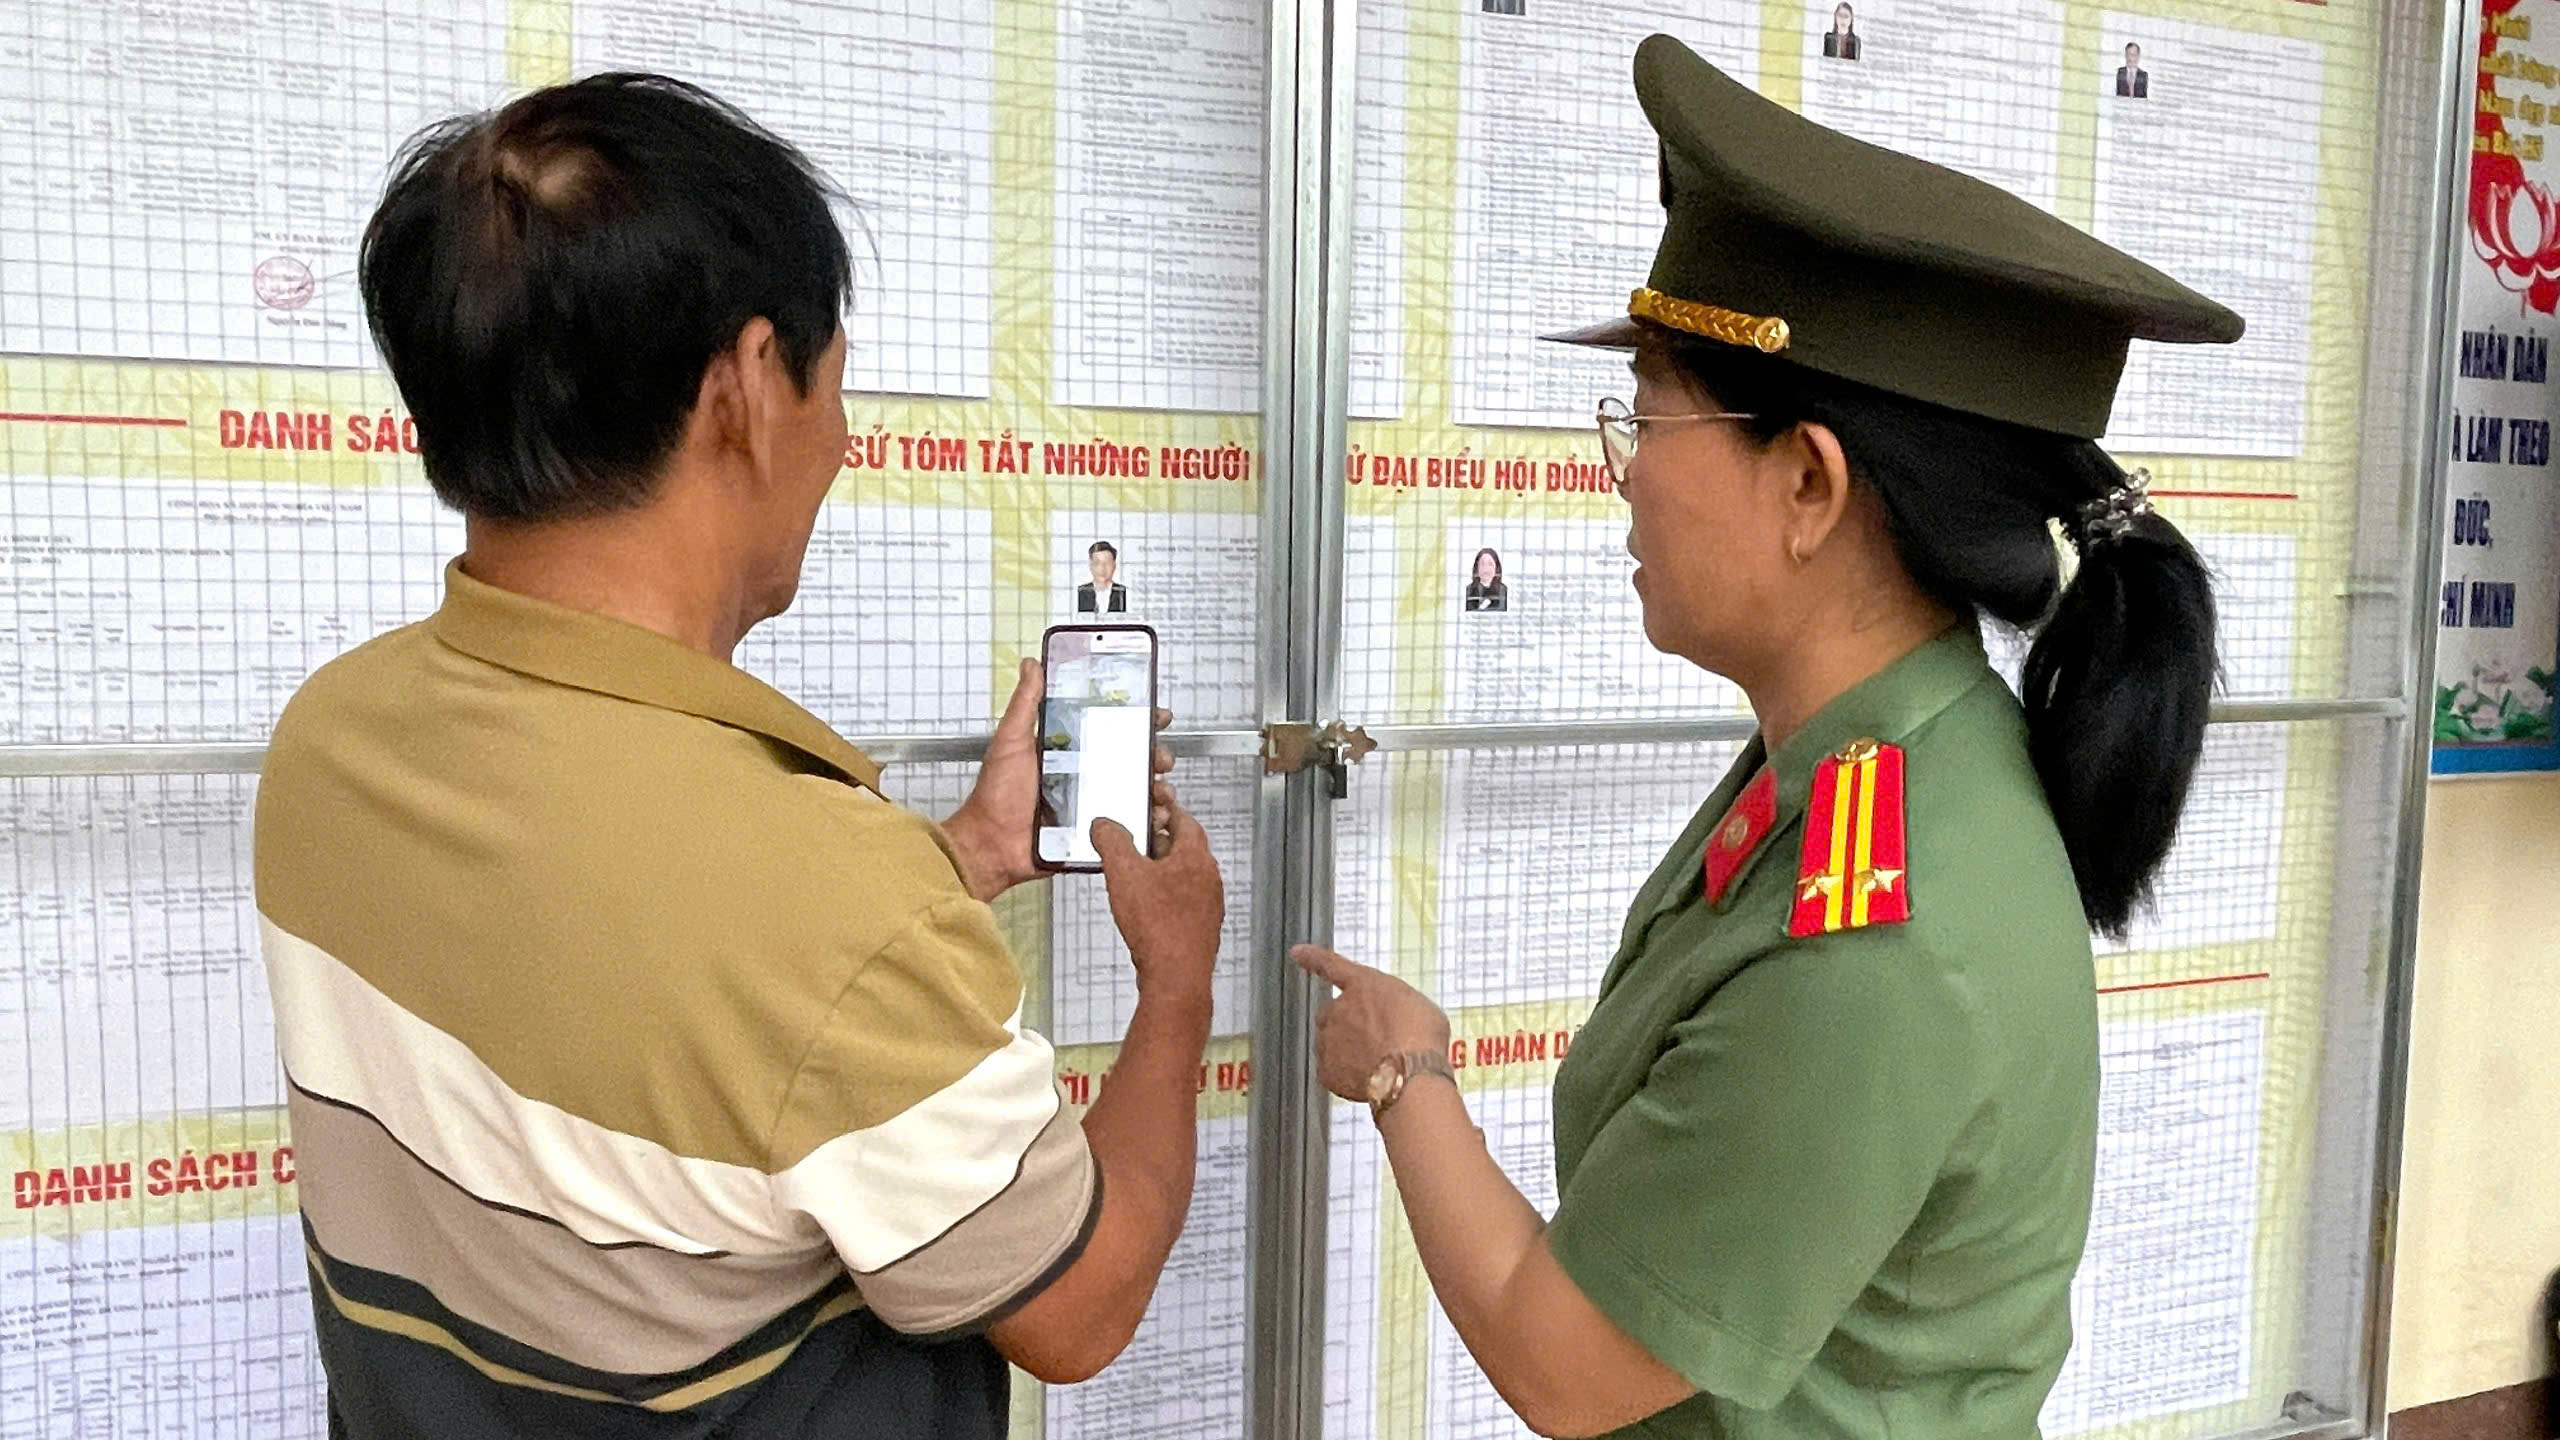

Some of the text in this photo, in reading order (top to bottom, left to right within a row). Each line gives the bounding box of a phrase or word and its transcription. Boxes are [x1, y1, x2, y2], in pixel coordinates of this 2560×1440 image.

[220, 409, 332, 451] DANH
[347, 408, 422, 453] SÁC
[844, 424, 891, 469] SỬ
[898, 430, 967, 472] TÓM
[978, 427, 1034, 474] TẮT
[1043, 437, 1150, 478] NHỮNG
[1160, 441, 1250, 481] NGƯỜI
[1345, 443, 1367, 485] Ử
[1372, 455, 1417, 494] ĐẠI
[1427, 446, 1486, 489] BIỂU
[1495, 455, 1537, 497] HỘI
[2508, 417, 2550, 466] THEO
[15, 1161, 132, 1209] DANH
[147, 1149, 258, 1196] SÁCH
[1476, 1028, 1546, 1067] NHÂN
